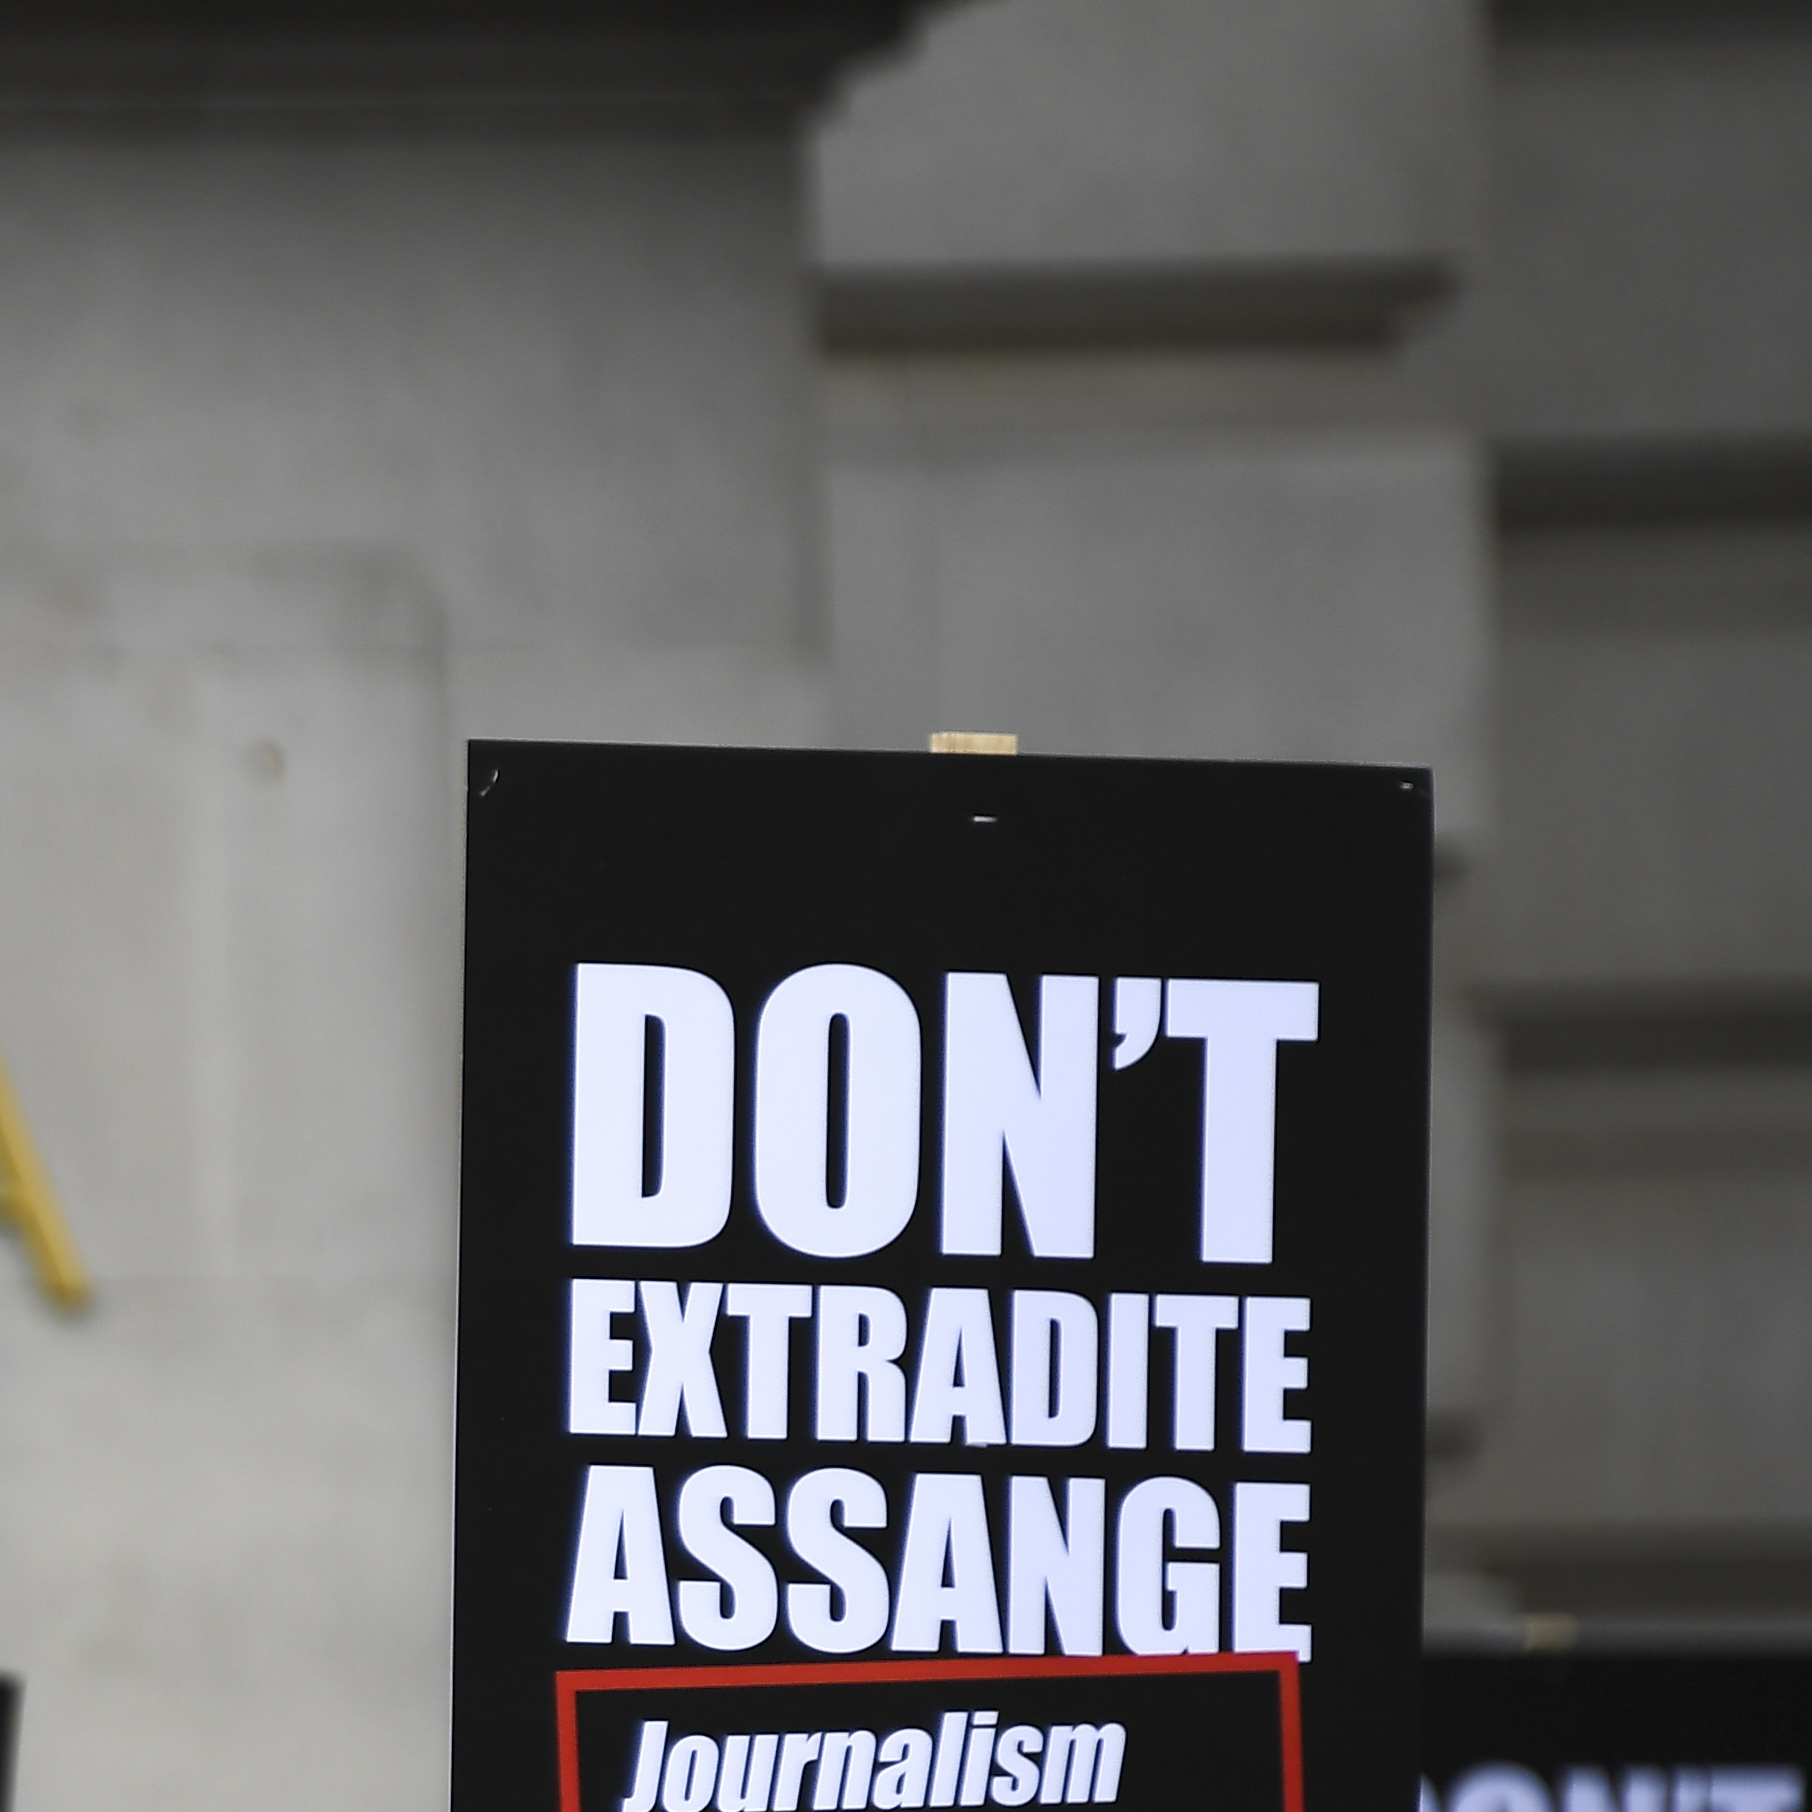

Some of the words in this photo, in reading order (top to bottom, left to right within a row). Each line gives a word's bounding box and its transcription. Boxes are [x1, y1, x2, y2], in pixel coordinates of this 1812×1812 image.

[572, 963, 1319, 1263] DON'T
[569, 1279, 1311, 1453] EXTRADITE
[566, 1465, 1311, 1662] ASSANGE
